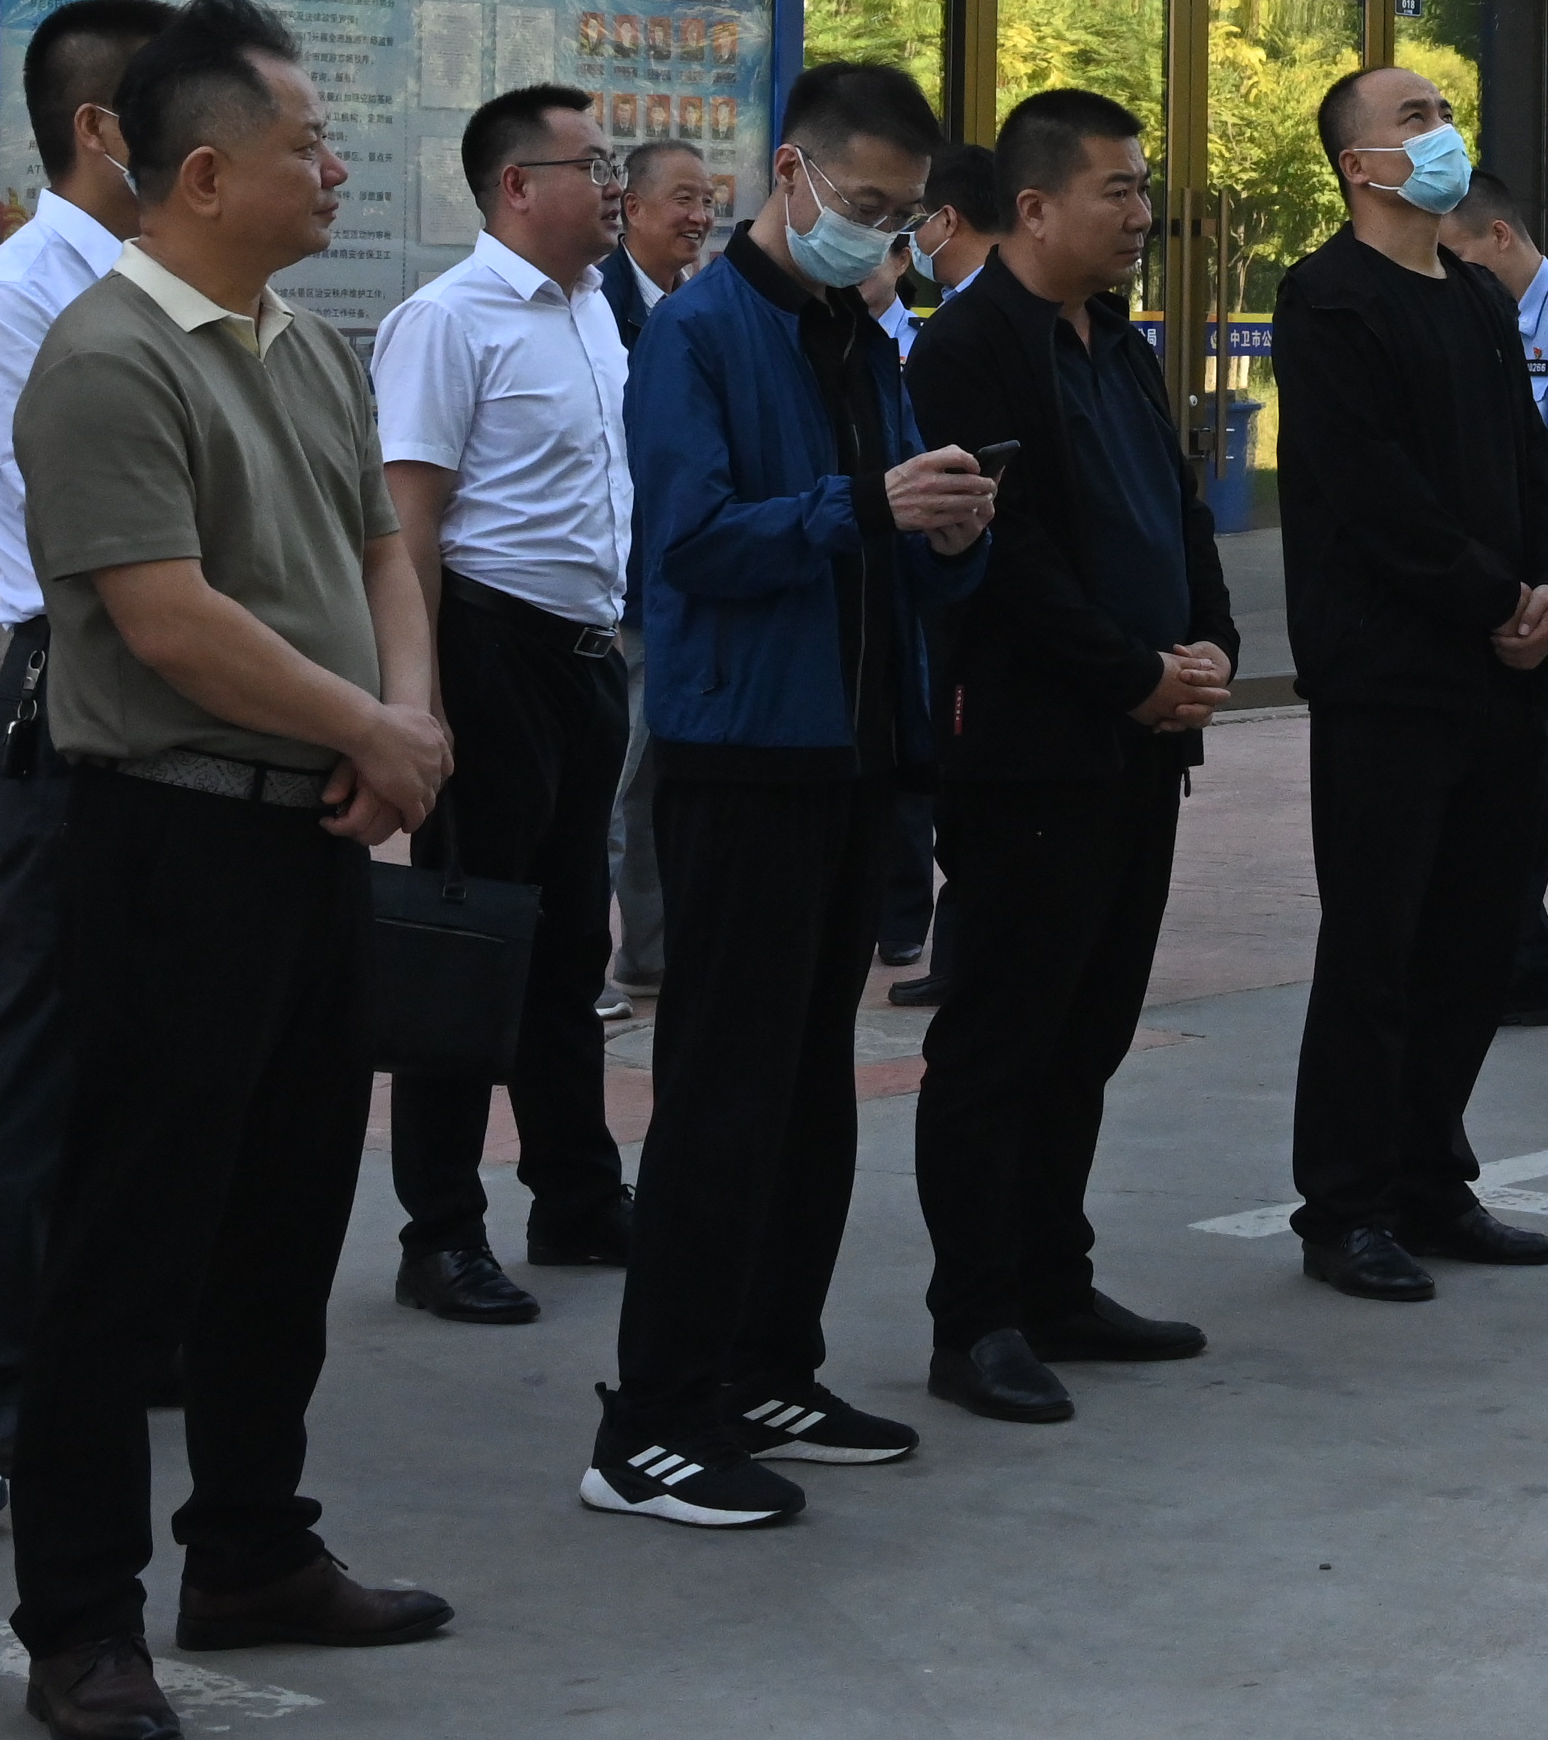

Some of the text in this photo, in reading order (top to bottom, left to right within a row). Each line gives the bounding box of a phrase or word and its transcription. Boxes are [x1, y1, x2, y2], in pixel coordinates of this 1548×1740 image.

[1402, 0, 1416, 10] 018
[1230, 329, 1273, 349] 中卫市公
